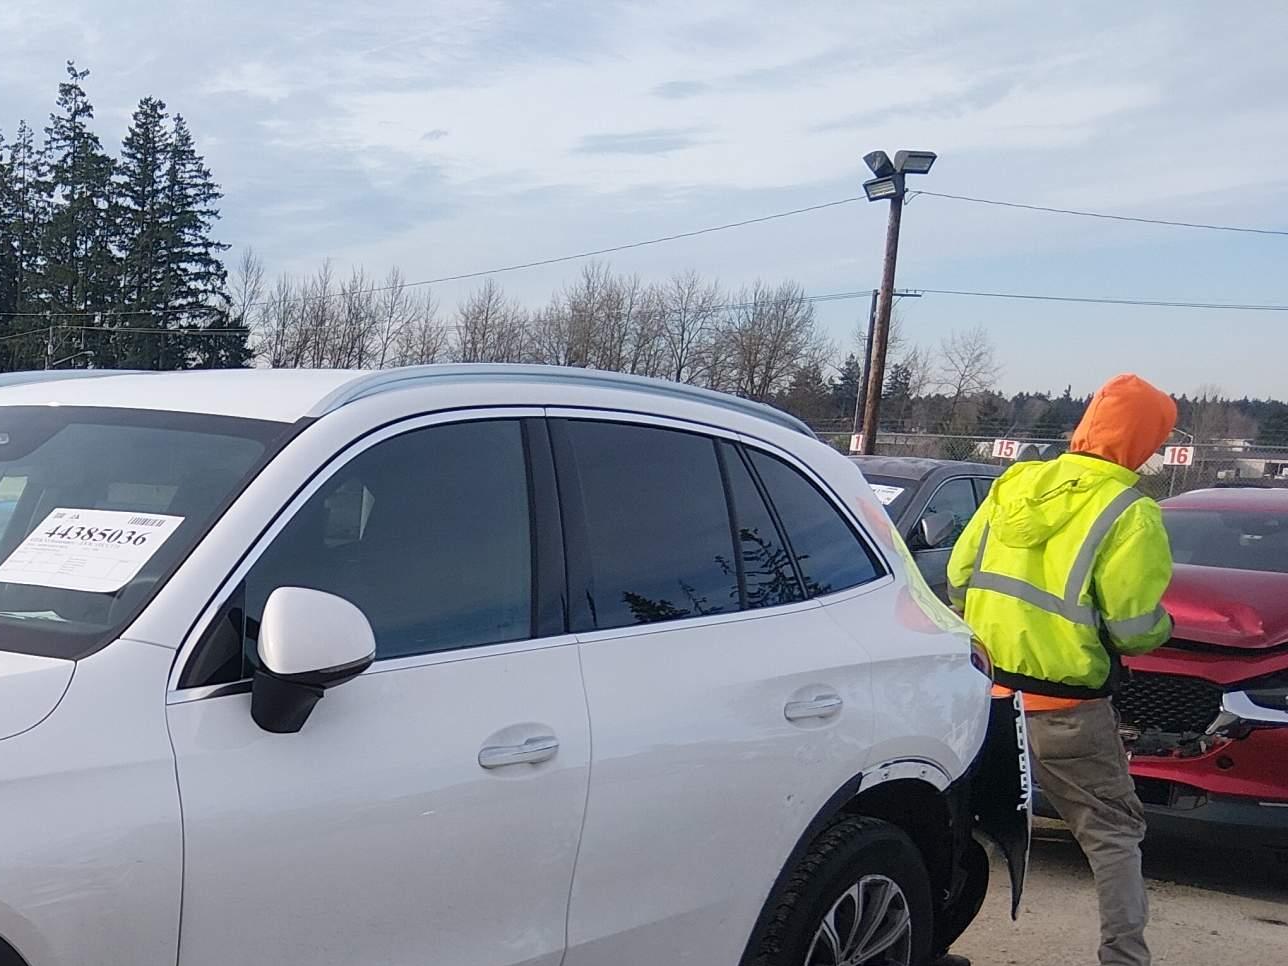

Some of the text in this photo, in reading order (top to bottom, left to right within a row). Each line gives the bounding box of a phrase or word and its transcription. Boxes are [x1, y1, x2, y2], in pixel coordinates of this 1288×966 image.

[997, 440, 1016, 458] 15
[1169, 446, 1189, 464] 16
[44, 524, 152, 547] 44385036
